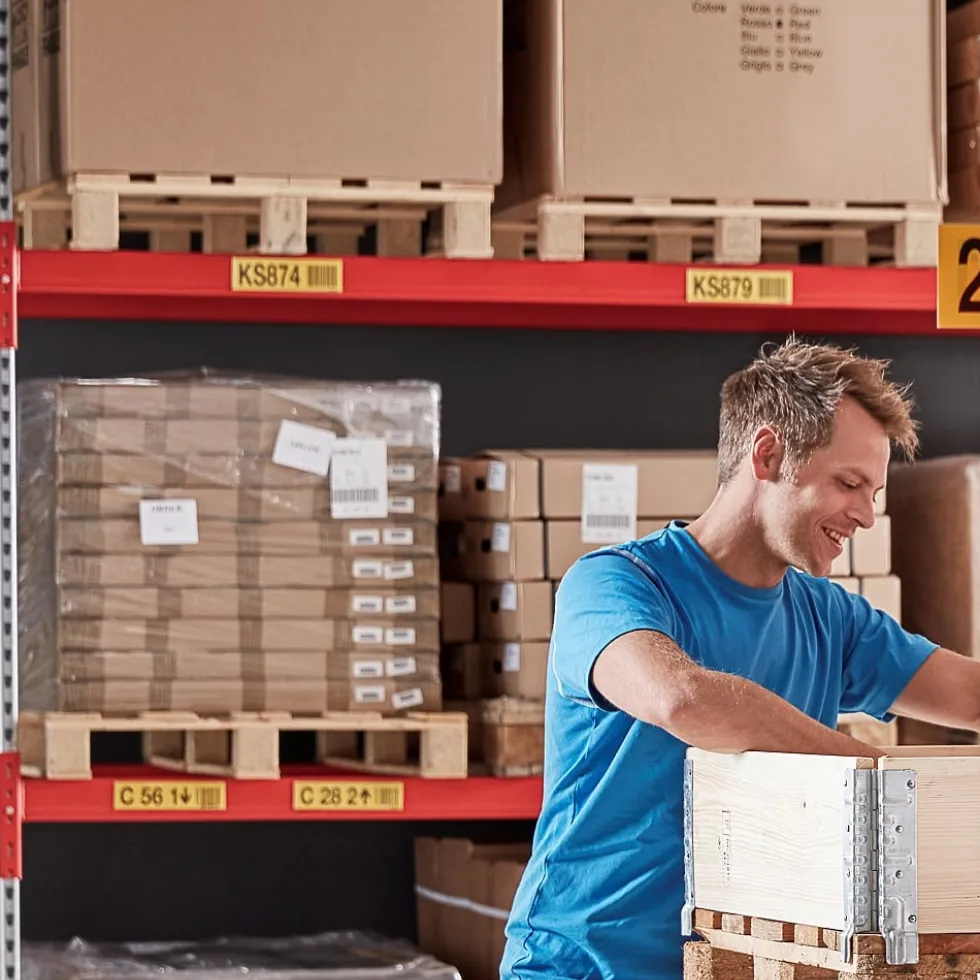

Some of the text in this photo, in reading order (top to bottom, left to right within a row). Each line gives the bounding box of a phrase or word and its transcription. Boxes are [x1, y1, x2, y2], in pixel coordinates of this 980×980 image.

[789, 5, 821, 16] Green
[740, 18, 811, 31] Rosso Red
[789, 47, 823, 59] Yellow
[238, 263, 301, 288] KS874
[693, 274, 754, 299] KS879
[120, 785, 178, 806] C 56 1
[300, 785, 358, 806] C 28 2
